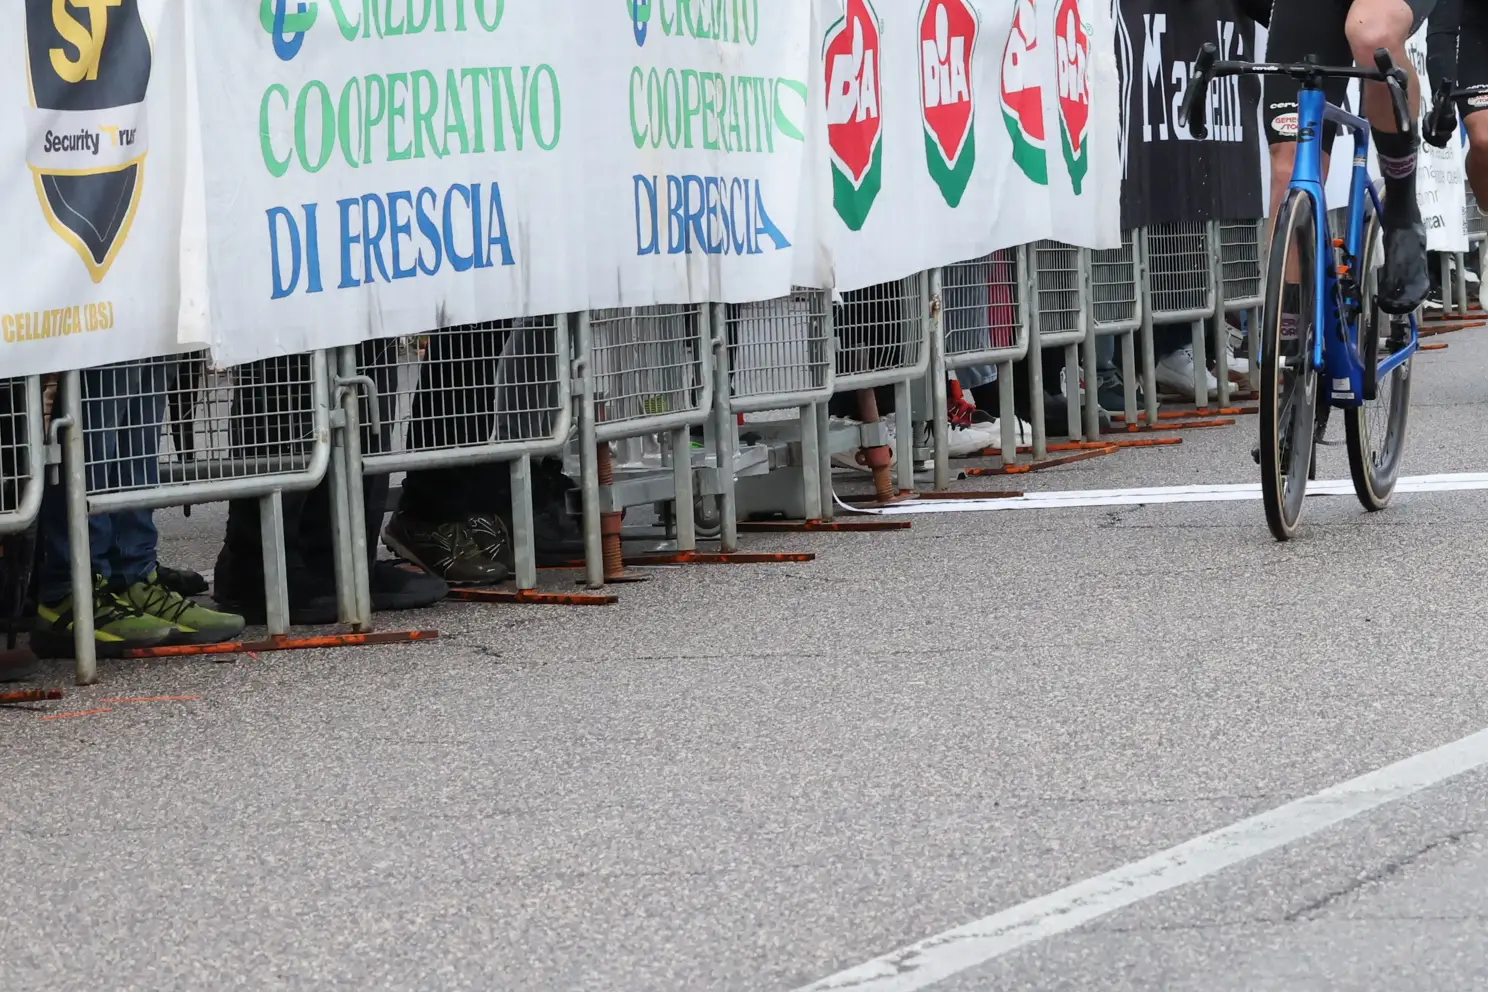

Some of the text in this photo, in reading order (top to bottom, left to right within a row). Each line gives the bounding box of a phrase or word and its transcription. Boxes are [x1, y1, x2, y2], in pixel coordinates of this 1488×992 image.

[1142, 13, 1244, 142] Maelli
[1269, 102, 1298, 110] cerv
[259, 63, 562, 178] COOPERATIVO
[1275, 117, 1298, 125] GENE
[265, 201, 323, 300] DI
[633, 173, 792, 257] DI BRESCIA
[1, 300, 114, 344] CELLATICA (BS)
